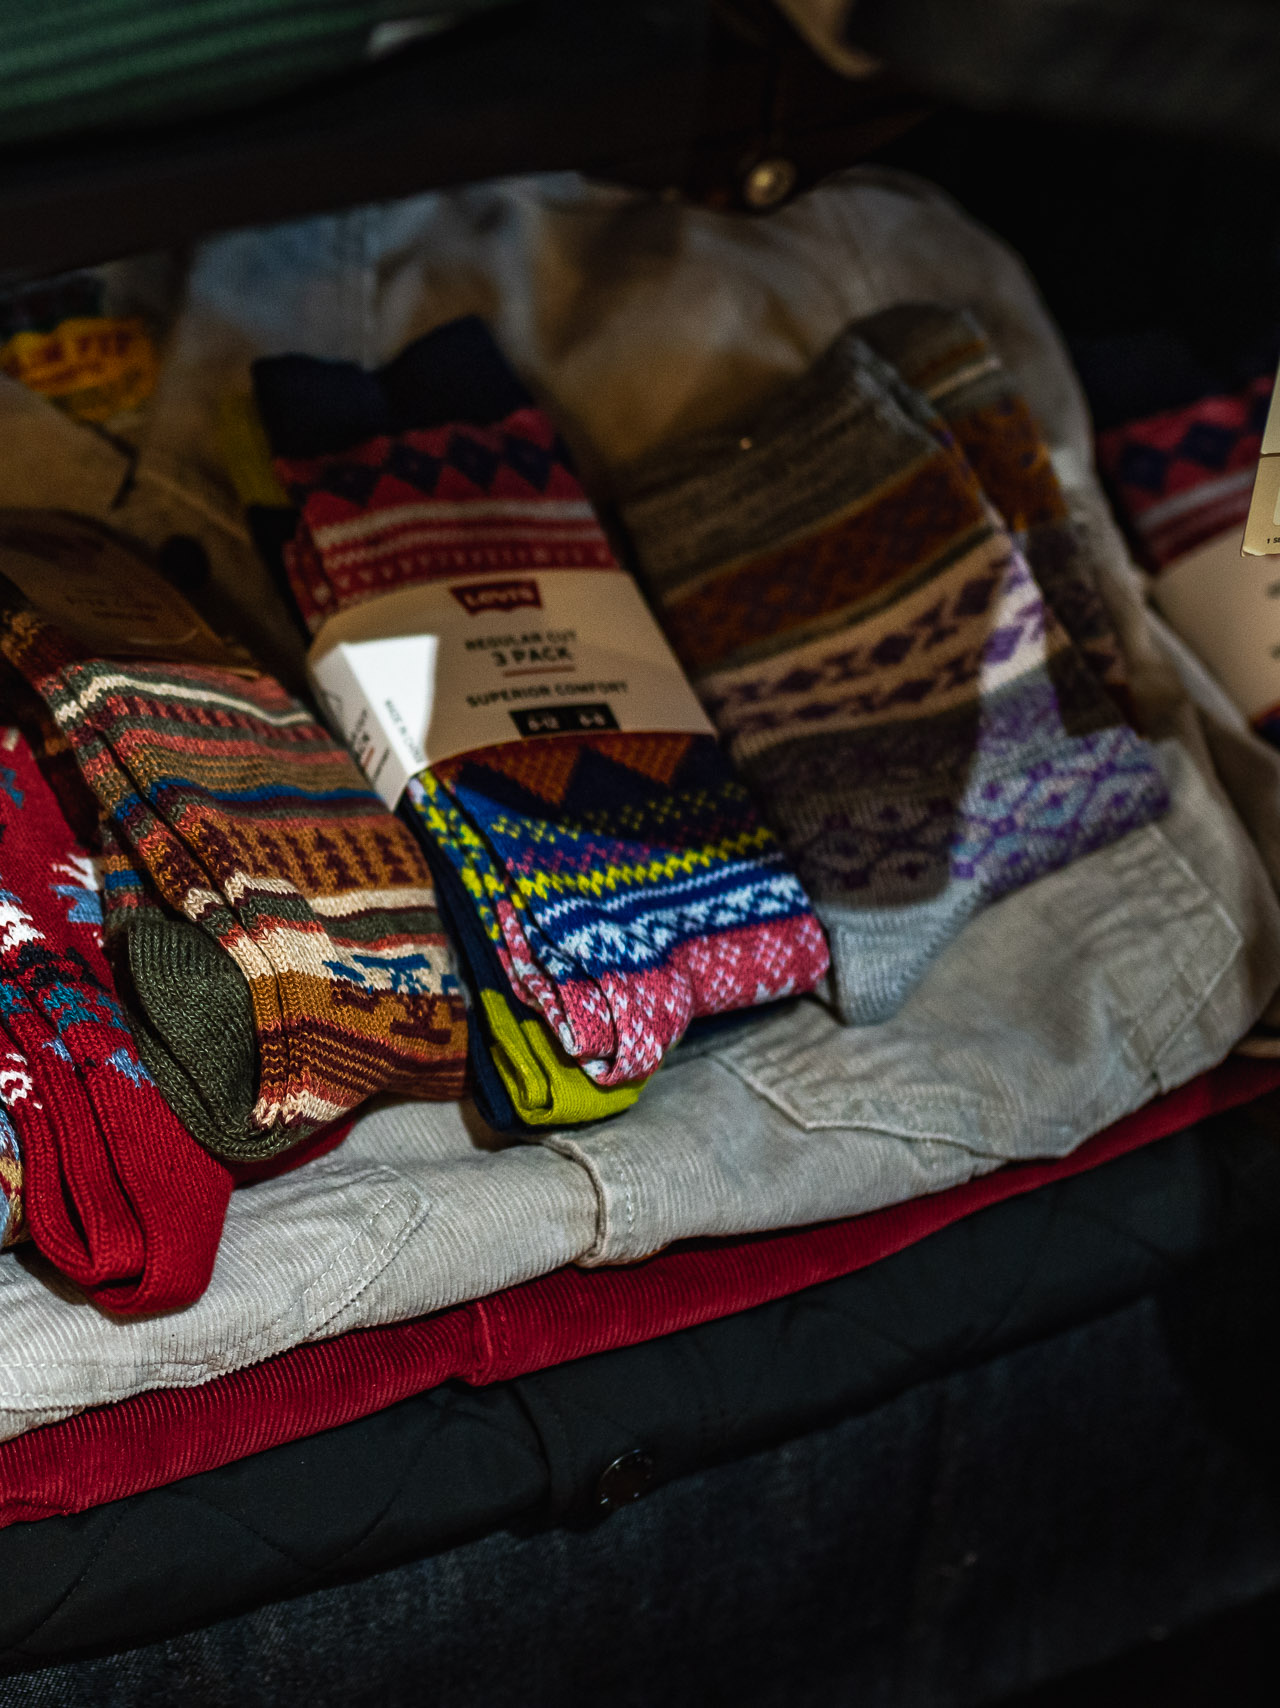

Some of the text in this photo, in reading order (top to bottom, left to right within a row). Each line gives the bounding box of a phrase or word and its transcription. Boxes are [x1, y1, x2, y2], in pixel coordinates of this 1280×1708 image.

[465, 630, 577, 650] REGULAR CUT
[491, 646, 574, 667] 3 PACK
[466, 681, 628, 708] SUPERIOR COMFORT
